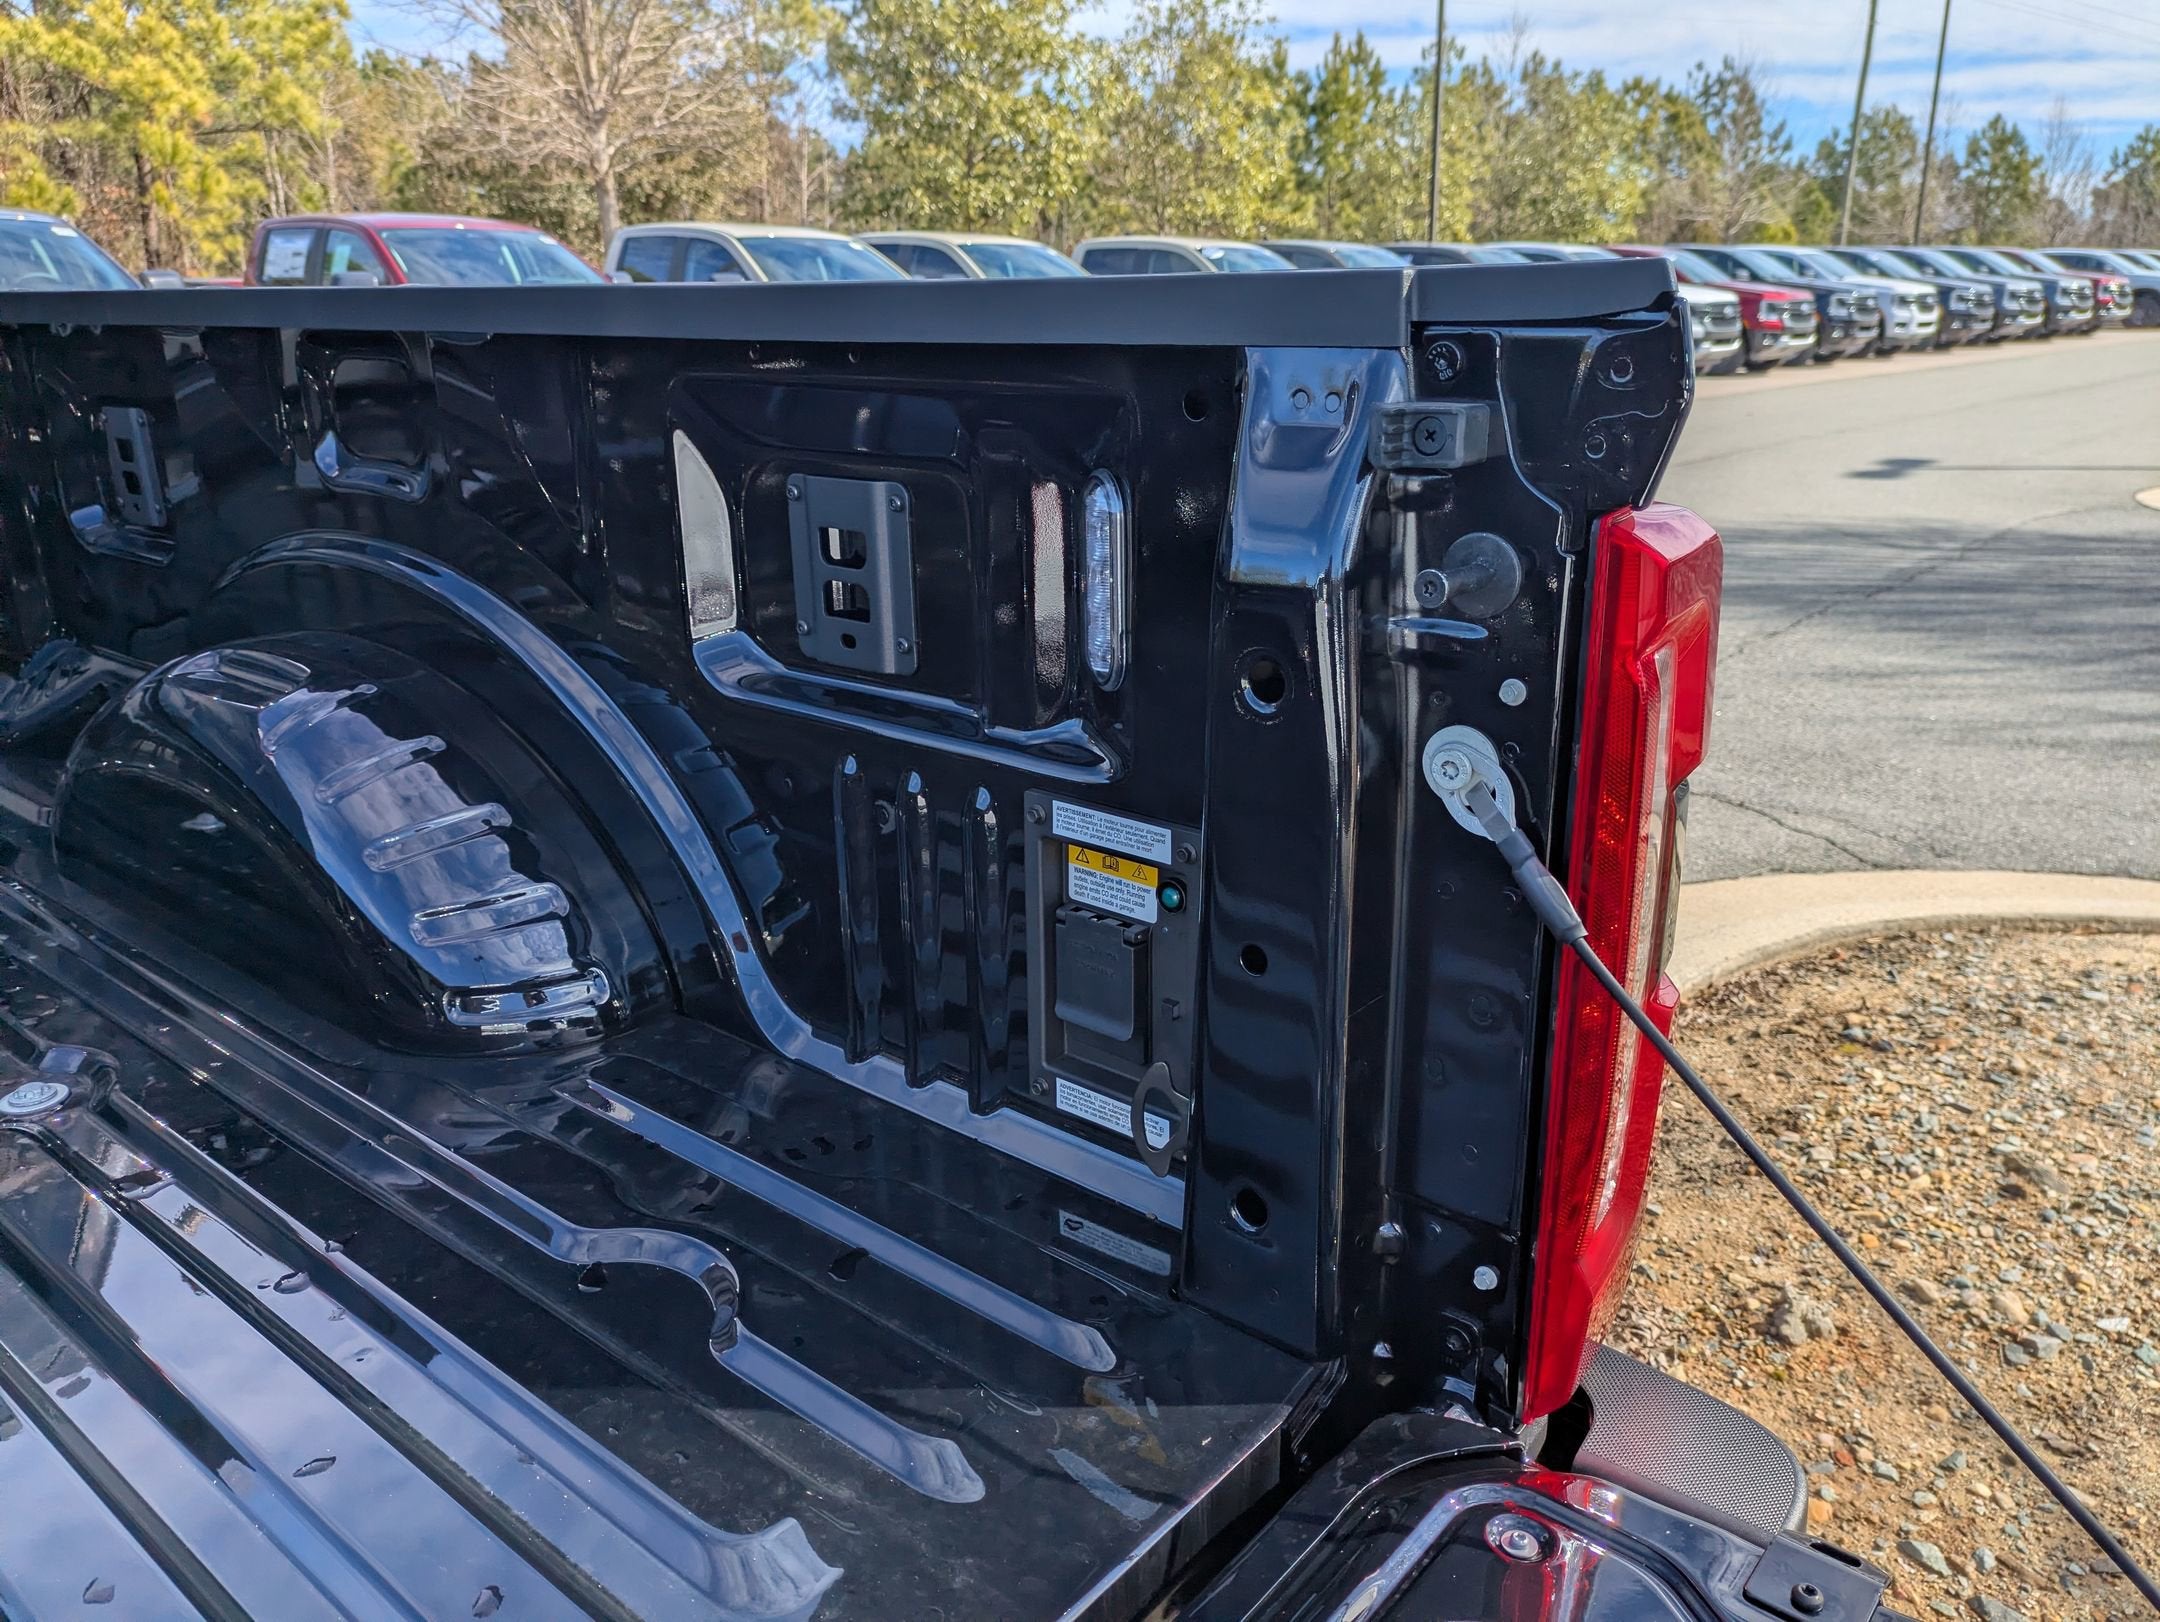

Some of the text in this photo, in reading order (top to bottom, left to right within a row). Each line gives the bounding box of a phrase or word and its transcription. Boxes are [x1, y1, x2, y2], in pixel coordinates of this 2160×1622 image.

[1057, 806, 1096, 821] AVERTISSEMENT:
[1150, 836, 1165, 845] Quand
[1074, 867, 1098, 879] WARNING:
[1099, 874, 1114, 885] Engine
[1137, 886, 1151, 896] power
[1119, 895, 1131, 904] could
[1132, 900, 1145, 909] cause
[1127, 890, 1145, 902] Running
